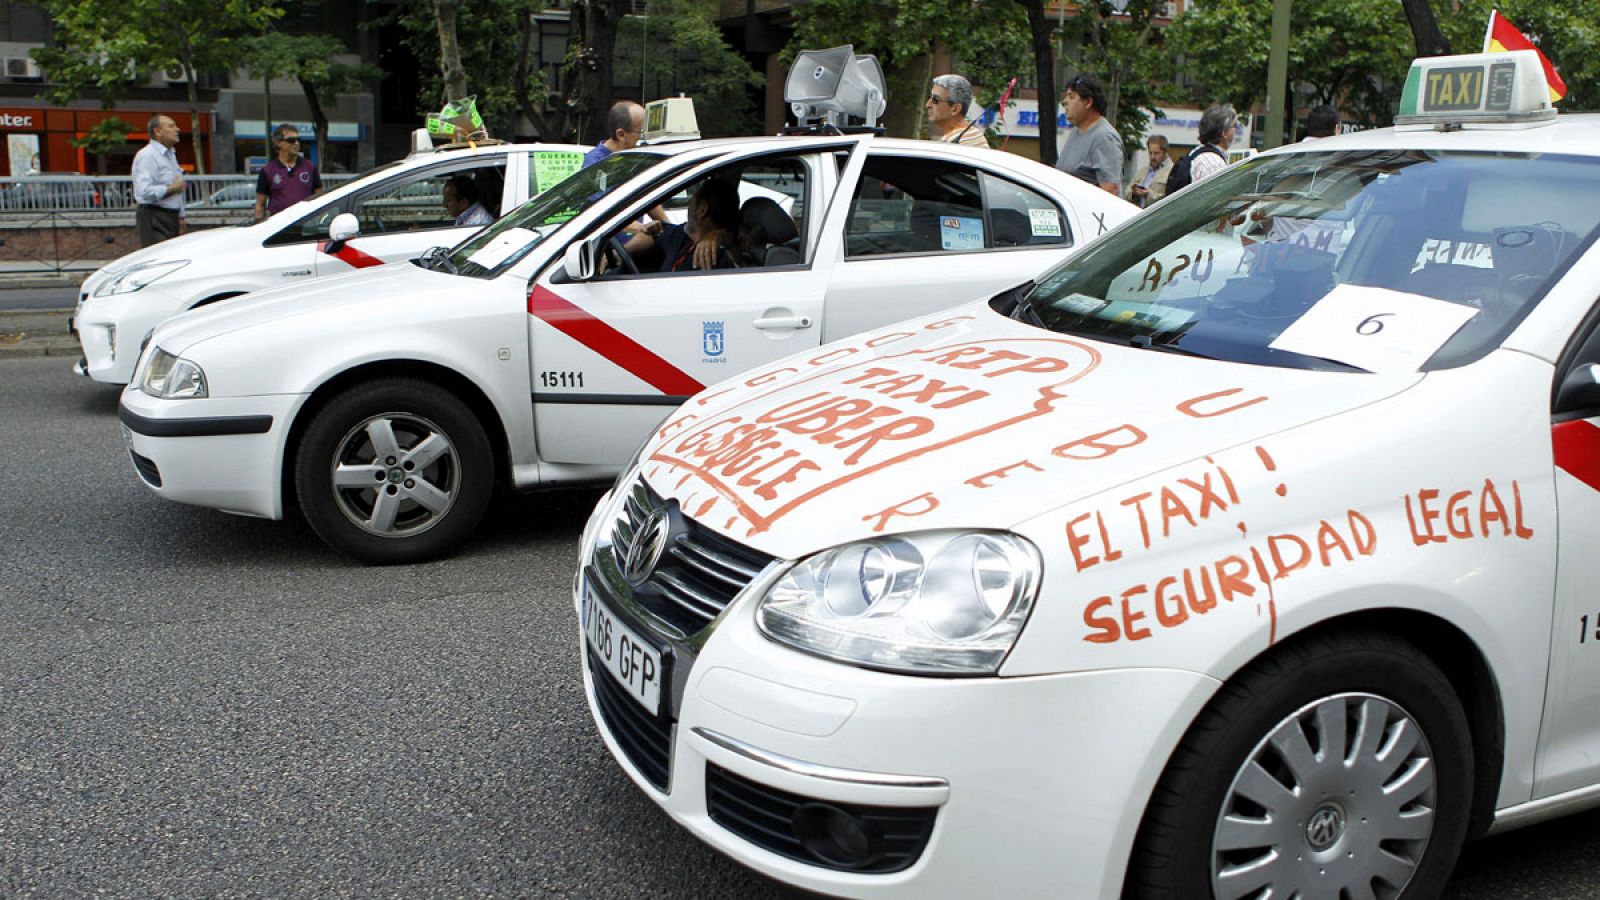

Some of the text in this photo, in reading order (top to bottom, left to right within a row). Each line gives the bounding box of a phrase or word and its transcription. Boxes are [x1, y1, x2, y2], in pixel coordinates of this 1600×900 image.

[1428, 71, 1483, 105] TAXI
[1356, 313, 1396, 336] 6
[540, 371, 584, 388] 15111
[921, 347, 1069, 378] RIP
[842, 367, 990, 410] TAXI
[756, 391, 934, 466] UBER
[1066, 511, 1123, 572] EL
[1083, 478, 1535, 645] SEGURIDAD LEGAL
[586, 590, 656, 697] 7166 GFP
